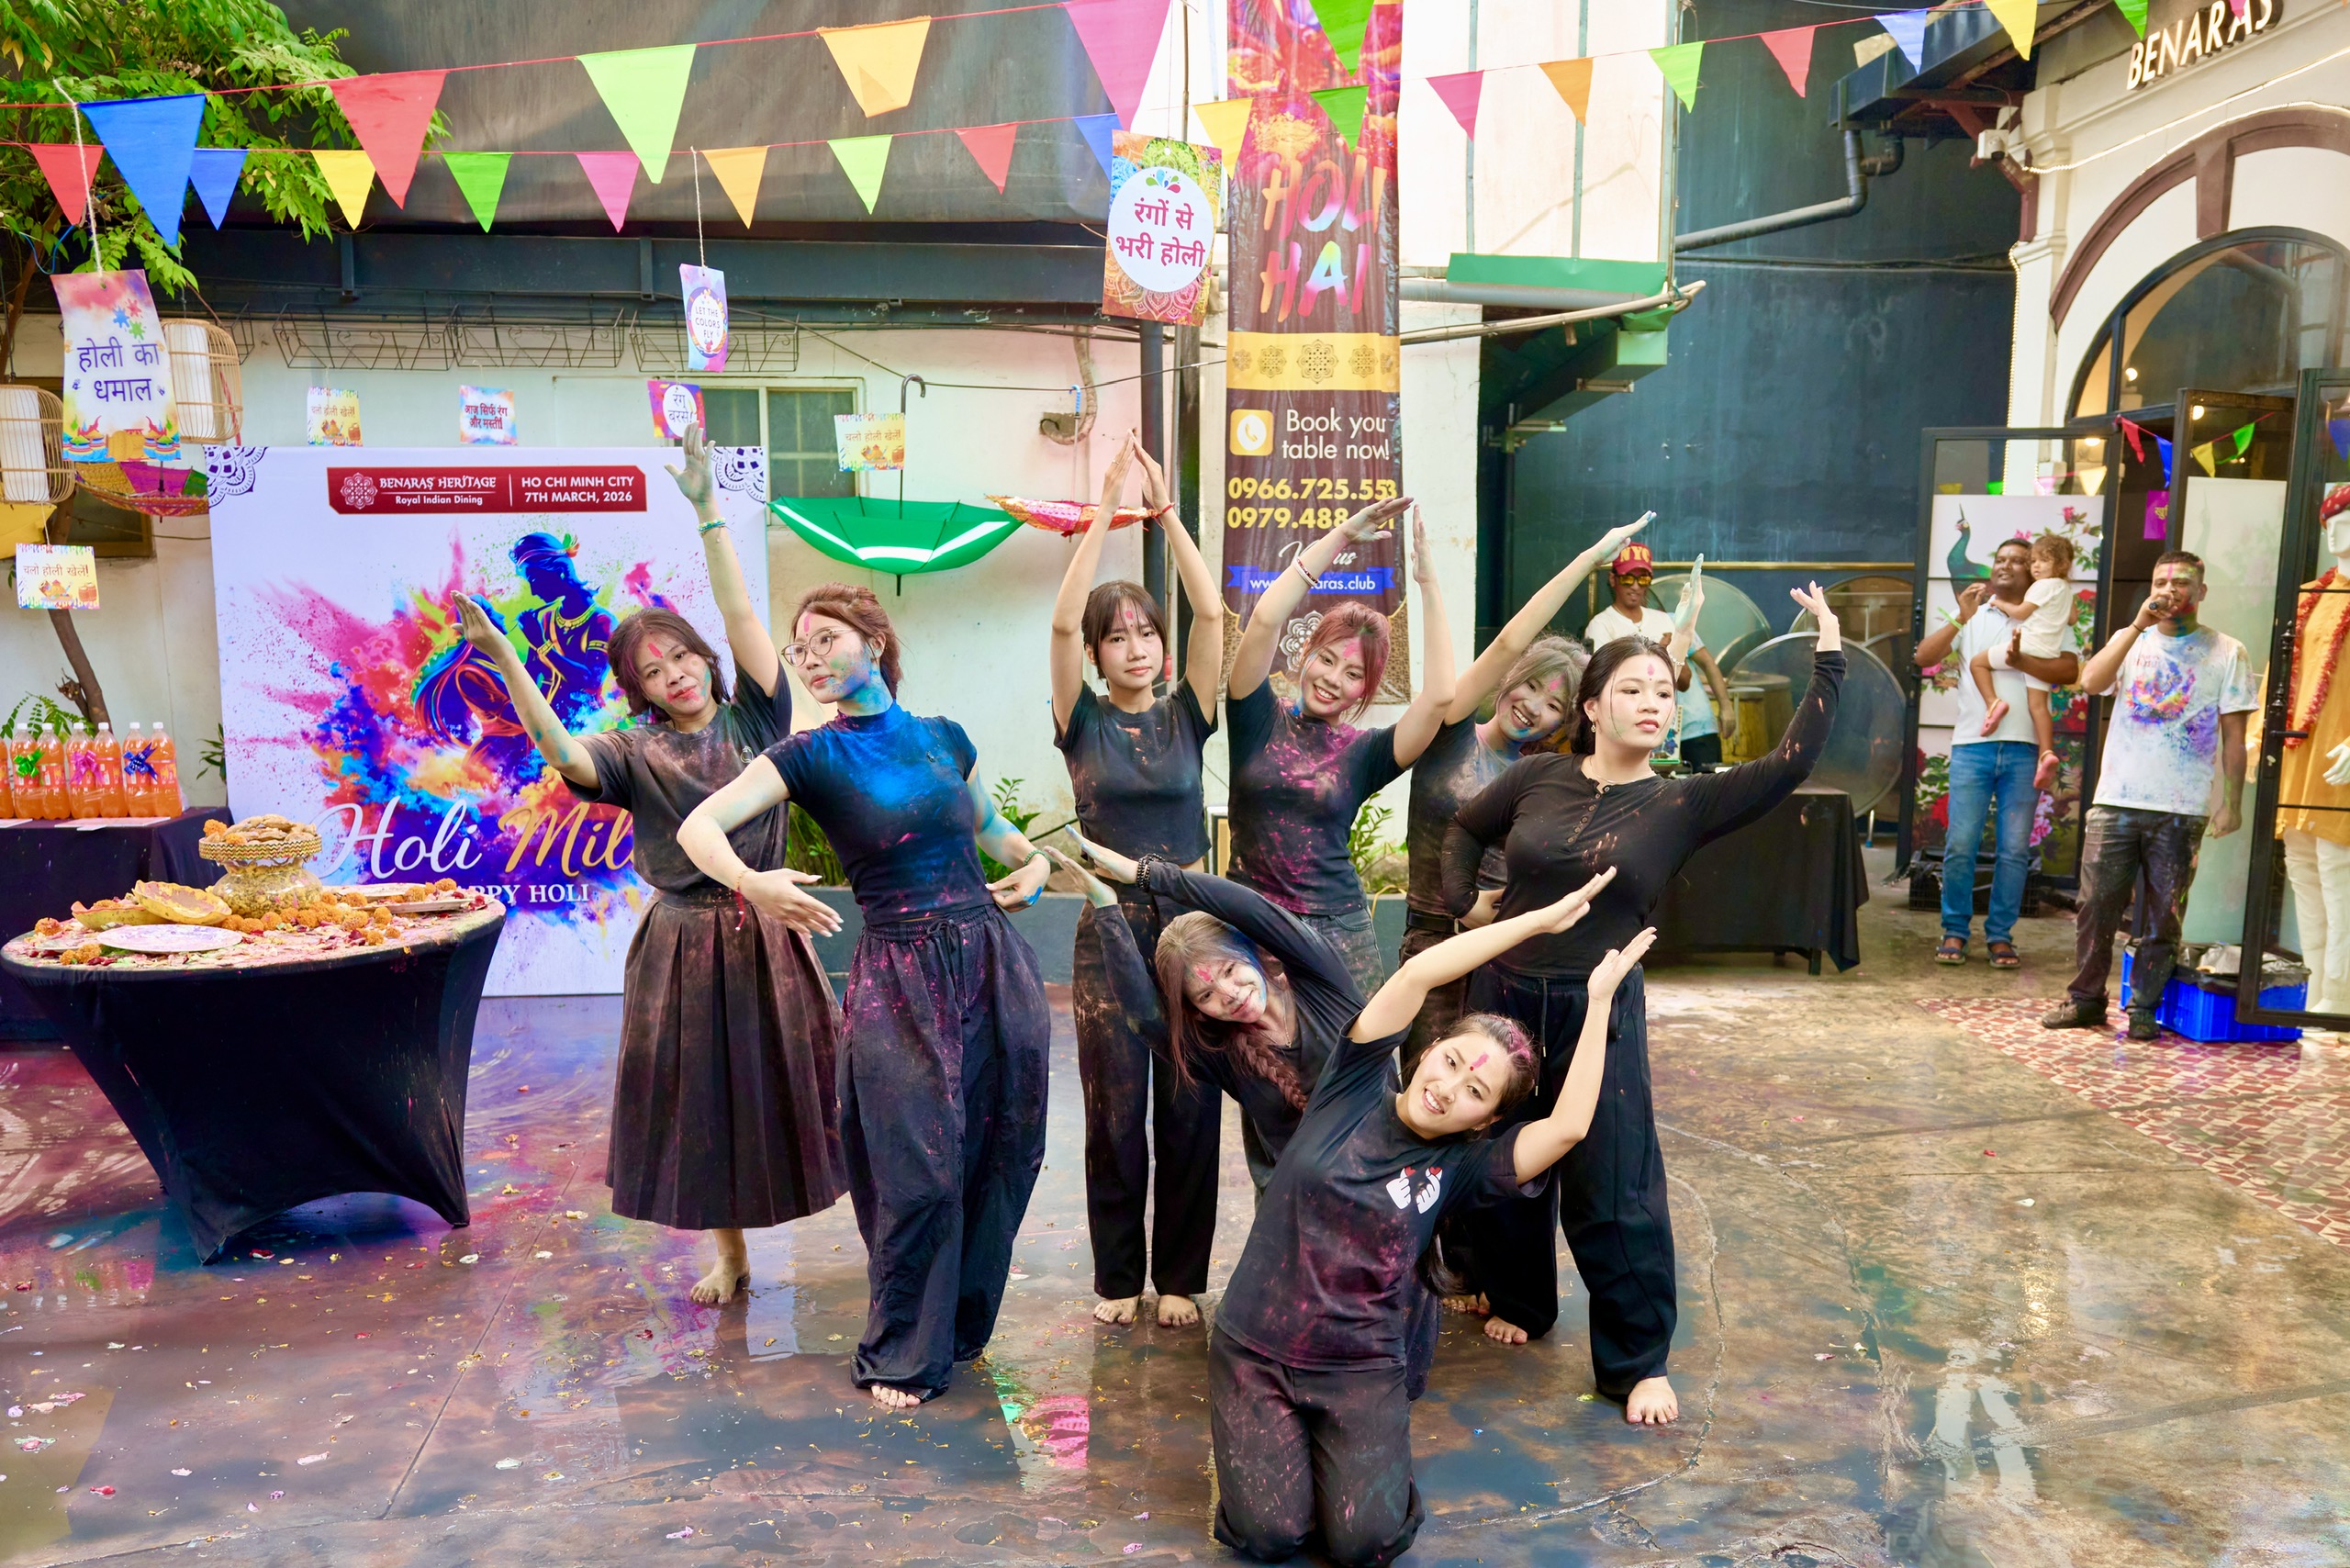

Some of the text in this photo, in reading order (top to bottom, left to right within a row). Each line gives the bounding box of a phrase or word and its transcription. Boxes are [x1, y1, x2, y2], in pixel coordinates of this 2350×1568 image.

[2126, 0, 2273, 91] BENARAS
[1261, 154, 1388, 242] HOLI
[1134, 197, 1194, 230] रंगों से
[1115, 232, 1206, 268] भरी होली
[1259, 241, 1372, 322] HAI
[695, 306, 719, 318] LET THE
[695, 317, 721, 329] COLORS
[703, 330, 714, 339] FLY
[77, 336, 160, 373] होली का
[94, 378, 152, 402] धमाल
[1286, 407, 1343, 432] Book
[845, 430, 862, 442] चलो
[865, 430, 882, 442] होली
[1281, 435, 1390, 460] table now!
[379, 475, 497, 491] BENARAS HERITAGE
[521, 476, 634, 487] HO CHI MINH CITY
[396, 495, 483, 506] Royal Indian Dining
[524, 491, 632, 504] 7TH MARCH, 2026
[1333, 553, 1358, 566] us
[1620, 545, 1651, 563] NYC
[23, 562, 39, 576] चलो
[42, 562, 63, 577] होली
[313, 795, 483, 879] Holi
[529, 884, 588, 902] HOLI
